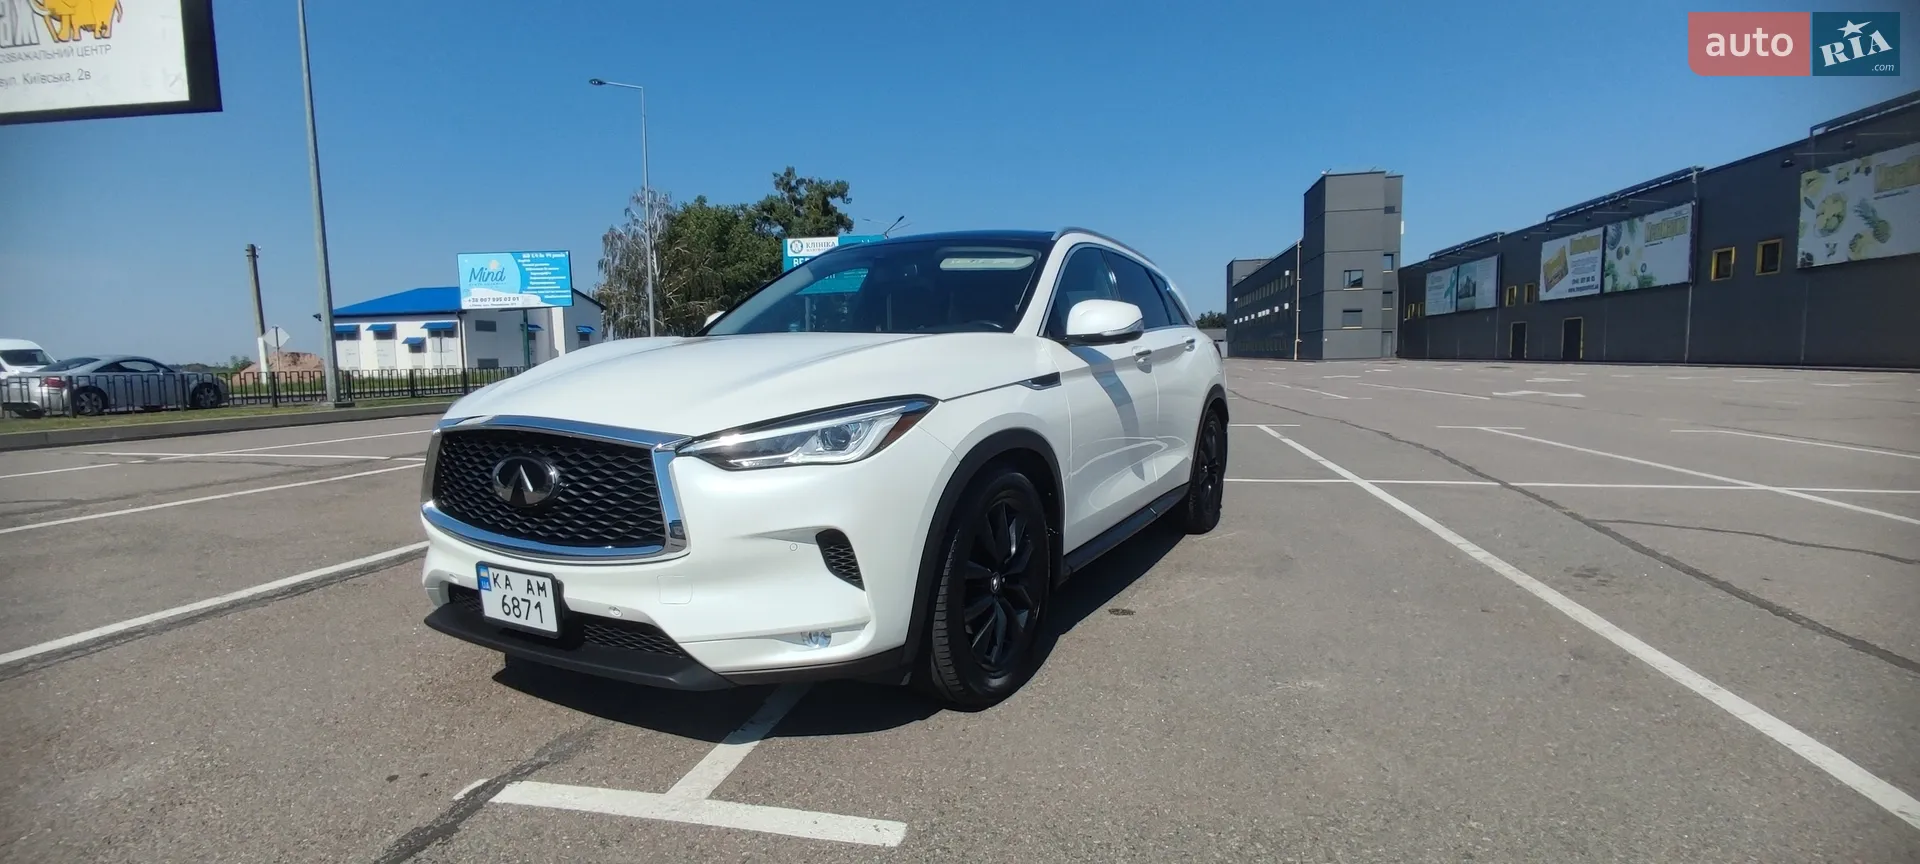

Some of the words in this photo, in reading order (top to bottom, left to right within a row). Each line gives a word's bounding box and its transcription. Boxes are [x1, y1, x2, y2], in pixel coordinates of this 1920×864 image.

[77, 44, 112, 58] ЦЕНТР
[22, 71, 75, 85] Київська,
[78, 68, 92, 81] 2в
[468, 266, 507, 283] Mind
[501, 594, 544, 624] 6871
